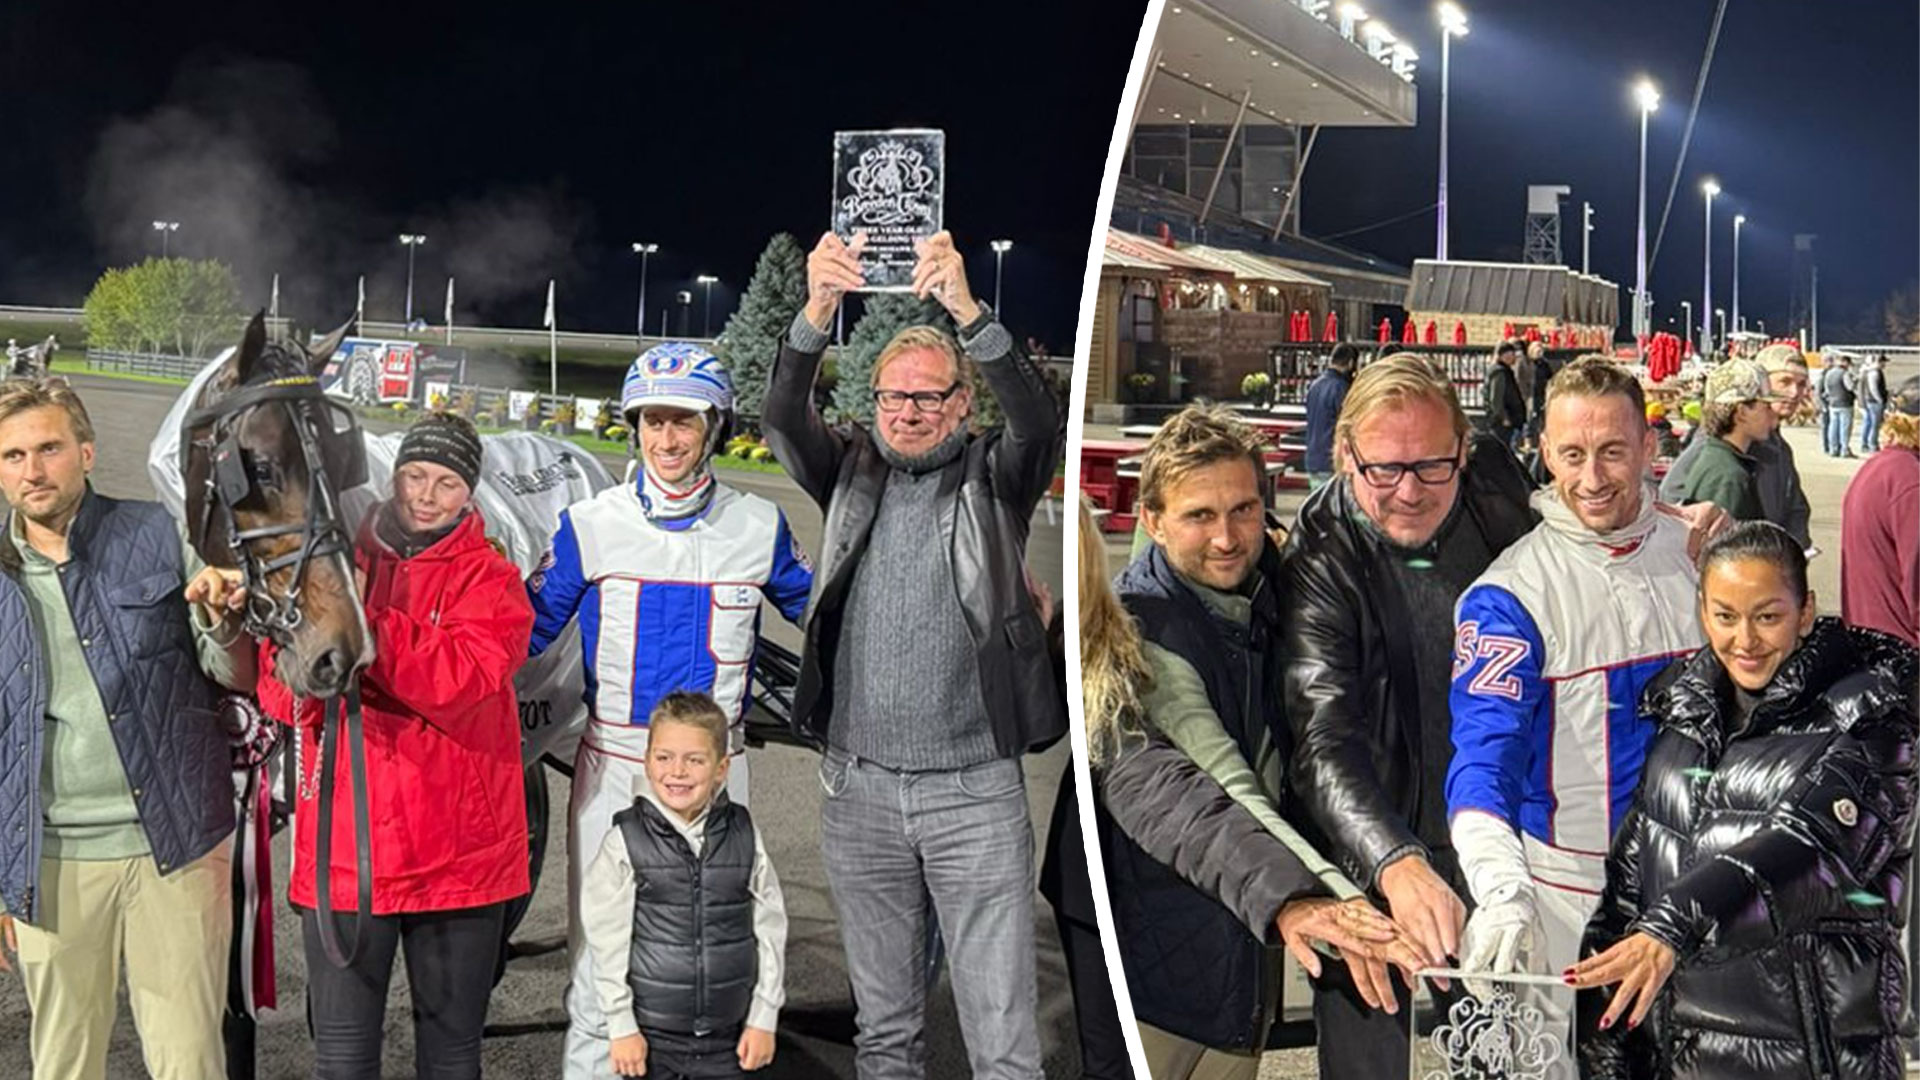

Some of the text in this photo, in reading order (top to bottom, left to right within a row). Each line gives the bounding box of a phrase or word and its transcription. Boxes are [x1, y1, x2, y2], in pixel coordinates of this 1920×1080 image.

[880, 226, 903, 234] YEAR
[904, 226, 924, 234] OLD
[1452, 620, 1531, 701] SZ
